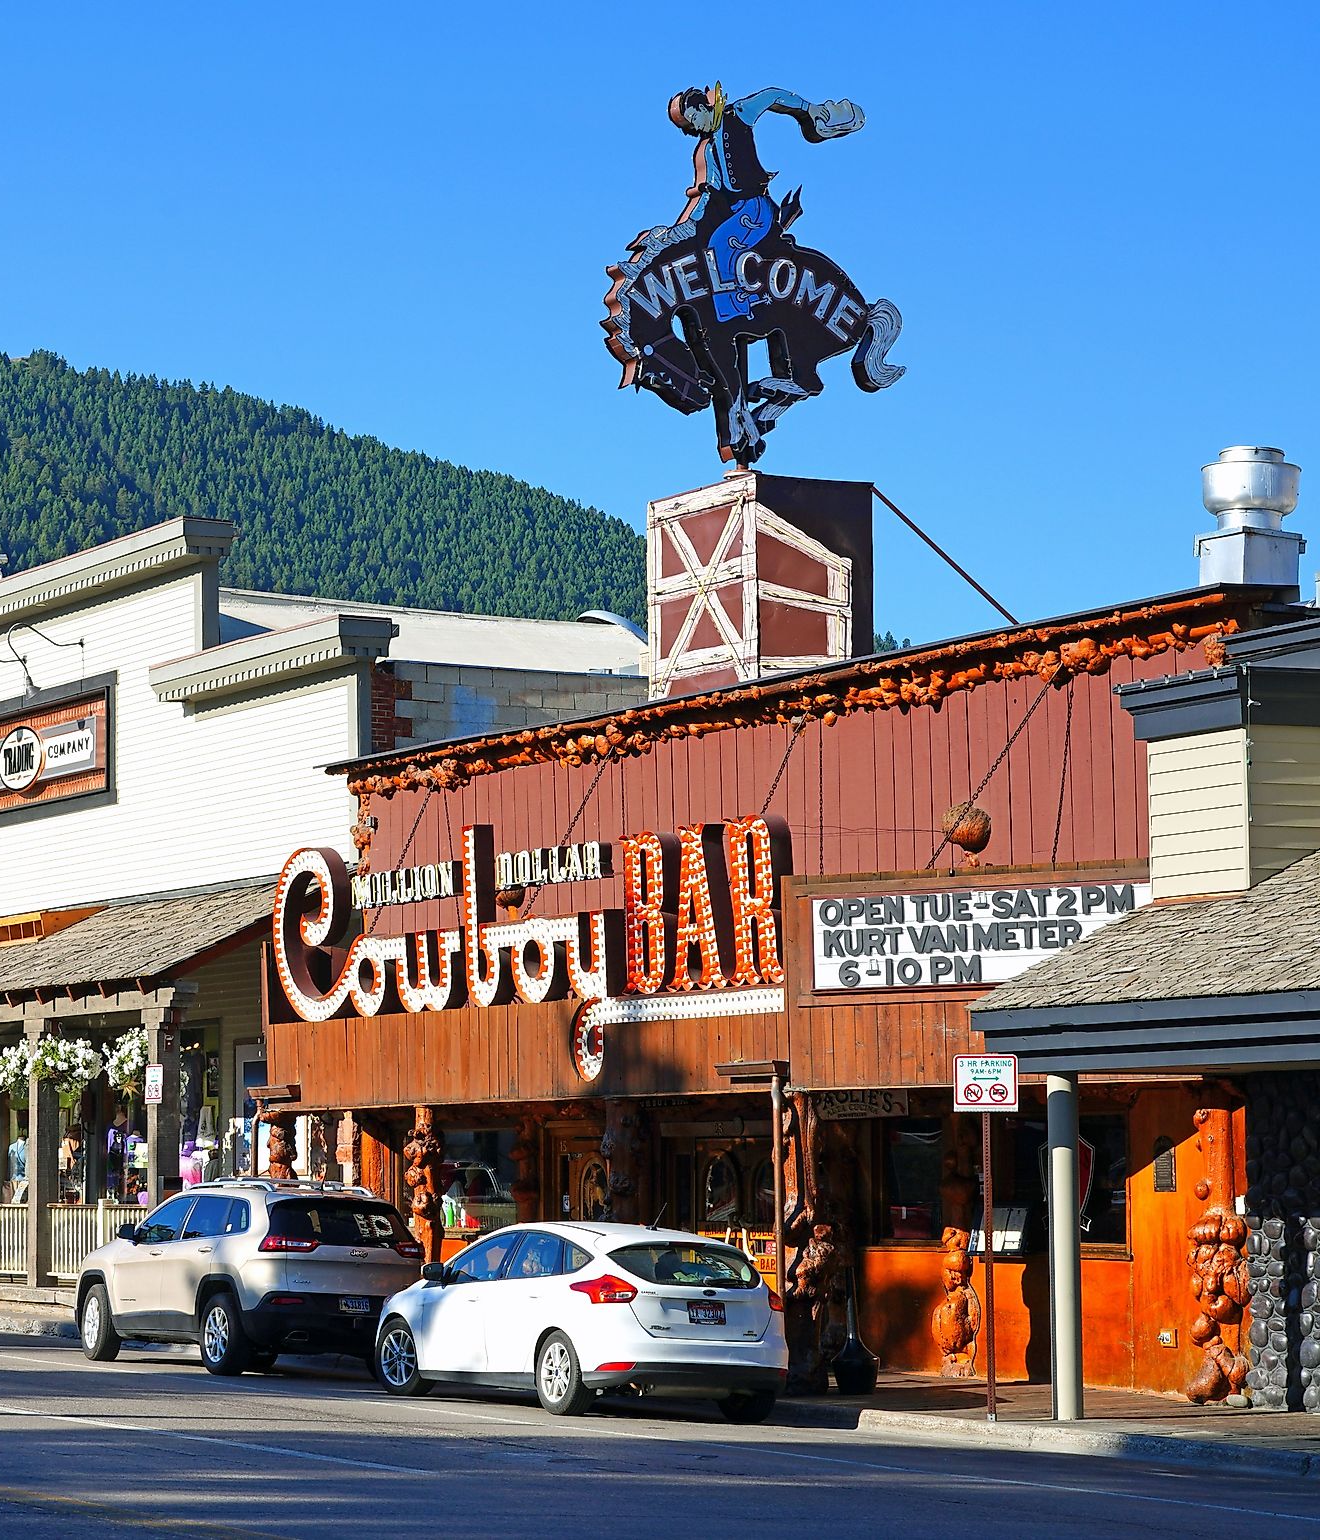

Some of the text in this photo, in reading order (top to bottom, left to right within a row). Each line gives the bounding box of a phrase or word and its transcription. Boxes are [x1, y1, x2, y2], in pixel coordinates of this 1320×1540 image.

[630, 249, 866, 342] WELCOME
[3, 742, 35, 776] TRADING
[48, 737, 90, 758] COMPANY
[351, 841, 602, 910] MILLION DOLLAR
[618, 813, 786, 996] BAR
[819, 895, 905, 927] OPEN
[823, 919, 1083, 958] KURT VAN METER
[838, 954, 983, 988] 6-10 PM
[959, 1060, 965, 1068] 3
[980, 1060, 1013, 1068] PARKING
[350, 1249, 368, 1258] Jeep
